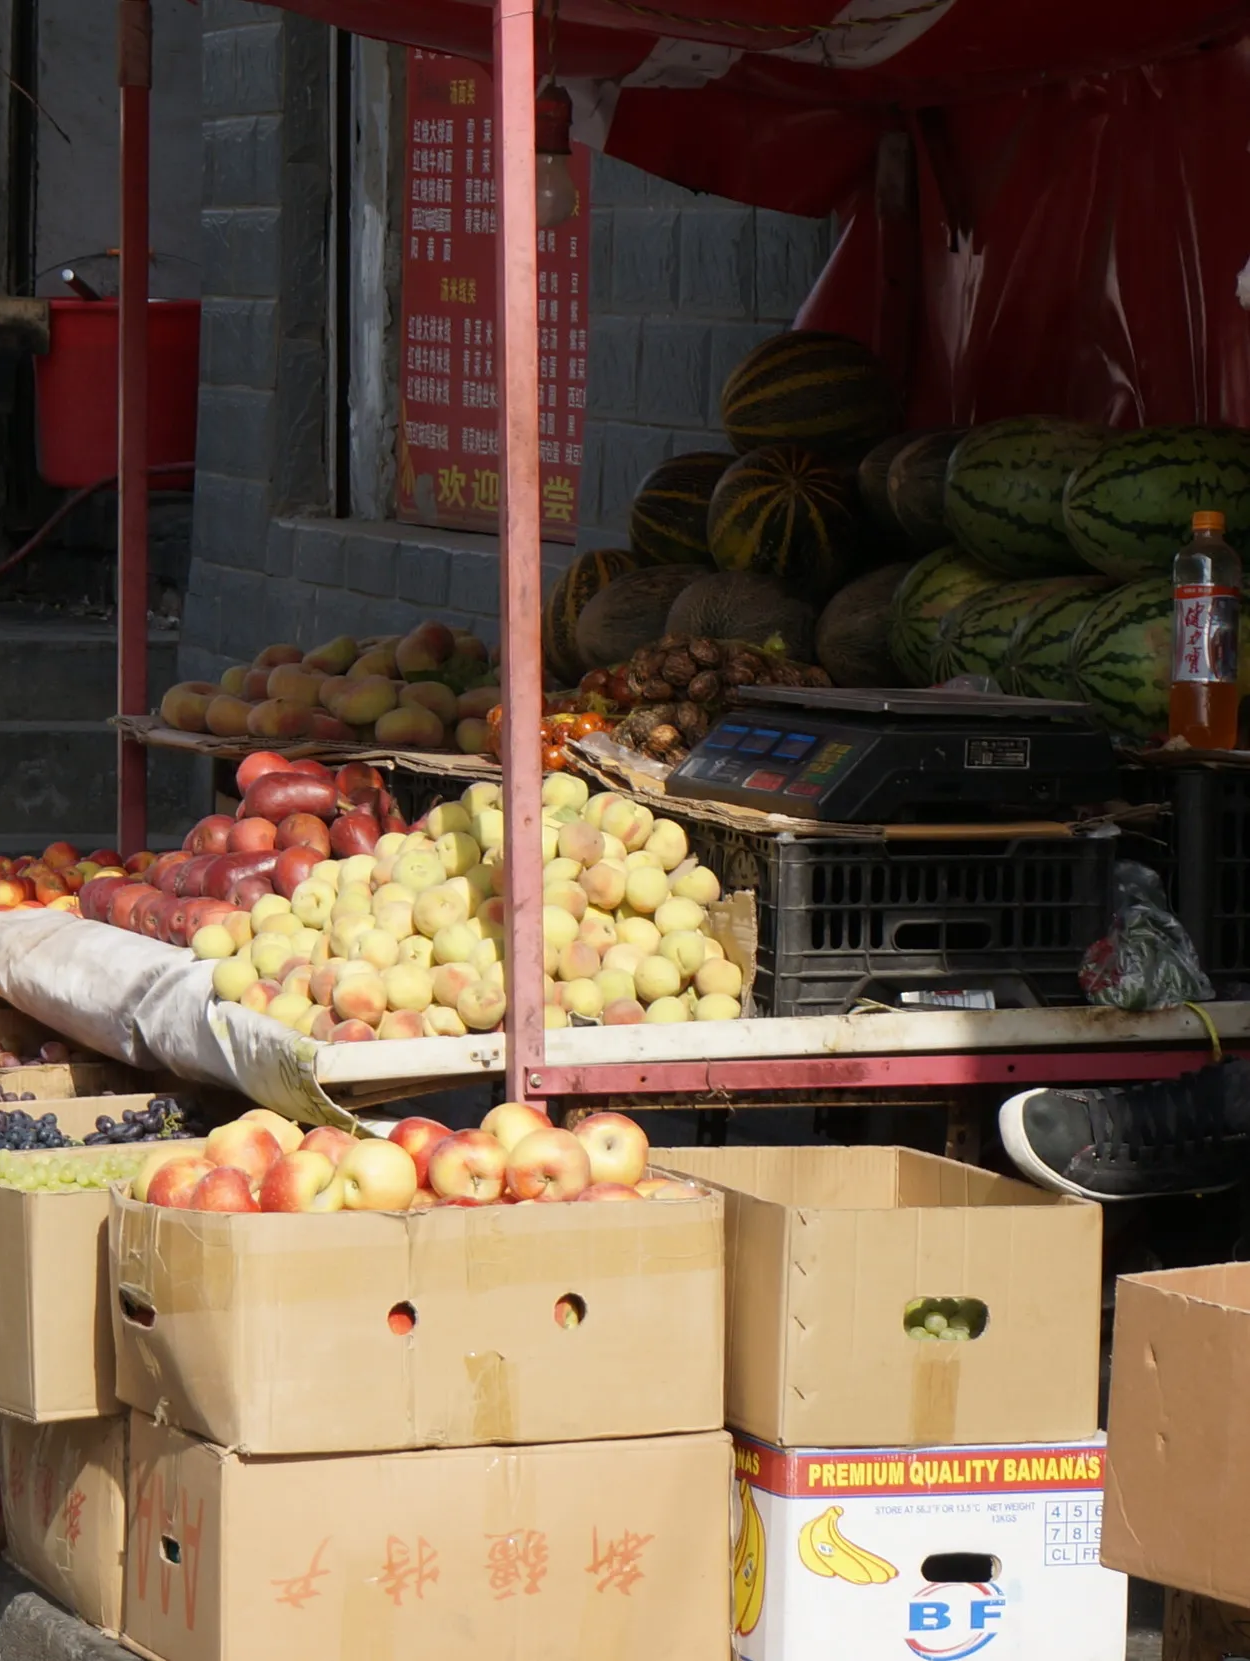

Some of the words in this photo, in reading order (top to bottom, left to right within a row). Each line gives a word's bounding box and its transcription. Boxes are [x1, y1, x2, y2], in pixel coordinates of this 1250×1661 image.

[808, 1463, 905, 1488] PREMIUM
[909, 1459, 999, 1486] QUALITY
[1002, 1456, 1101, 1482] BANANAS
[875, 1504, 902, 1515] STORE
[904, 1504, 914, 1514] AT
[941, 1503, 955, 1513] OR
[986, 1502, 1002, 1512] NET
[1003, 1501, 1036, 1512] WEIGHT
[1051, 1506, 1060, 1518] 4
[1073, 1505, 1083, 1518] 5
[1094, 1504, 1103, 1517] 6
[1051, 1527, 1060, 1541] 7
[1072, 1527, 1082, 1540] 8
[1051, 1548, 1071, 1561] CL
